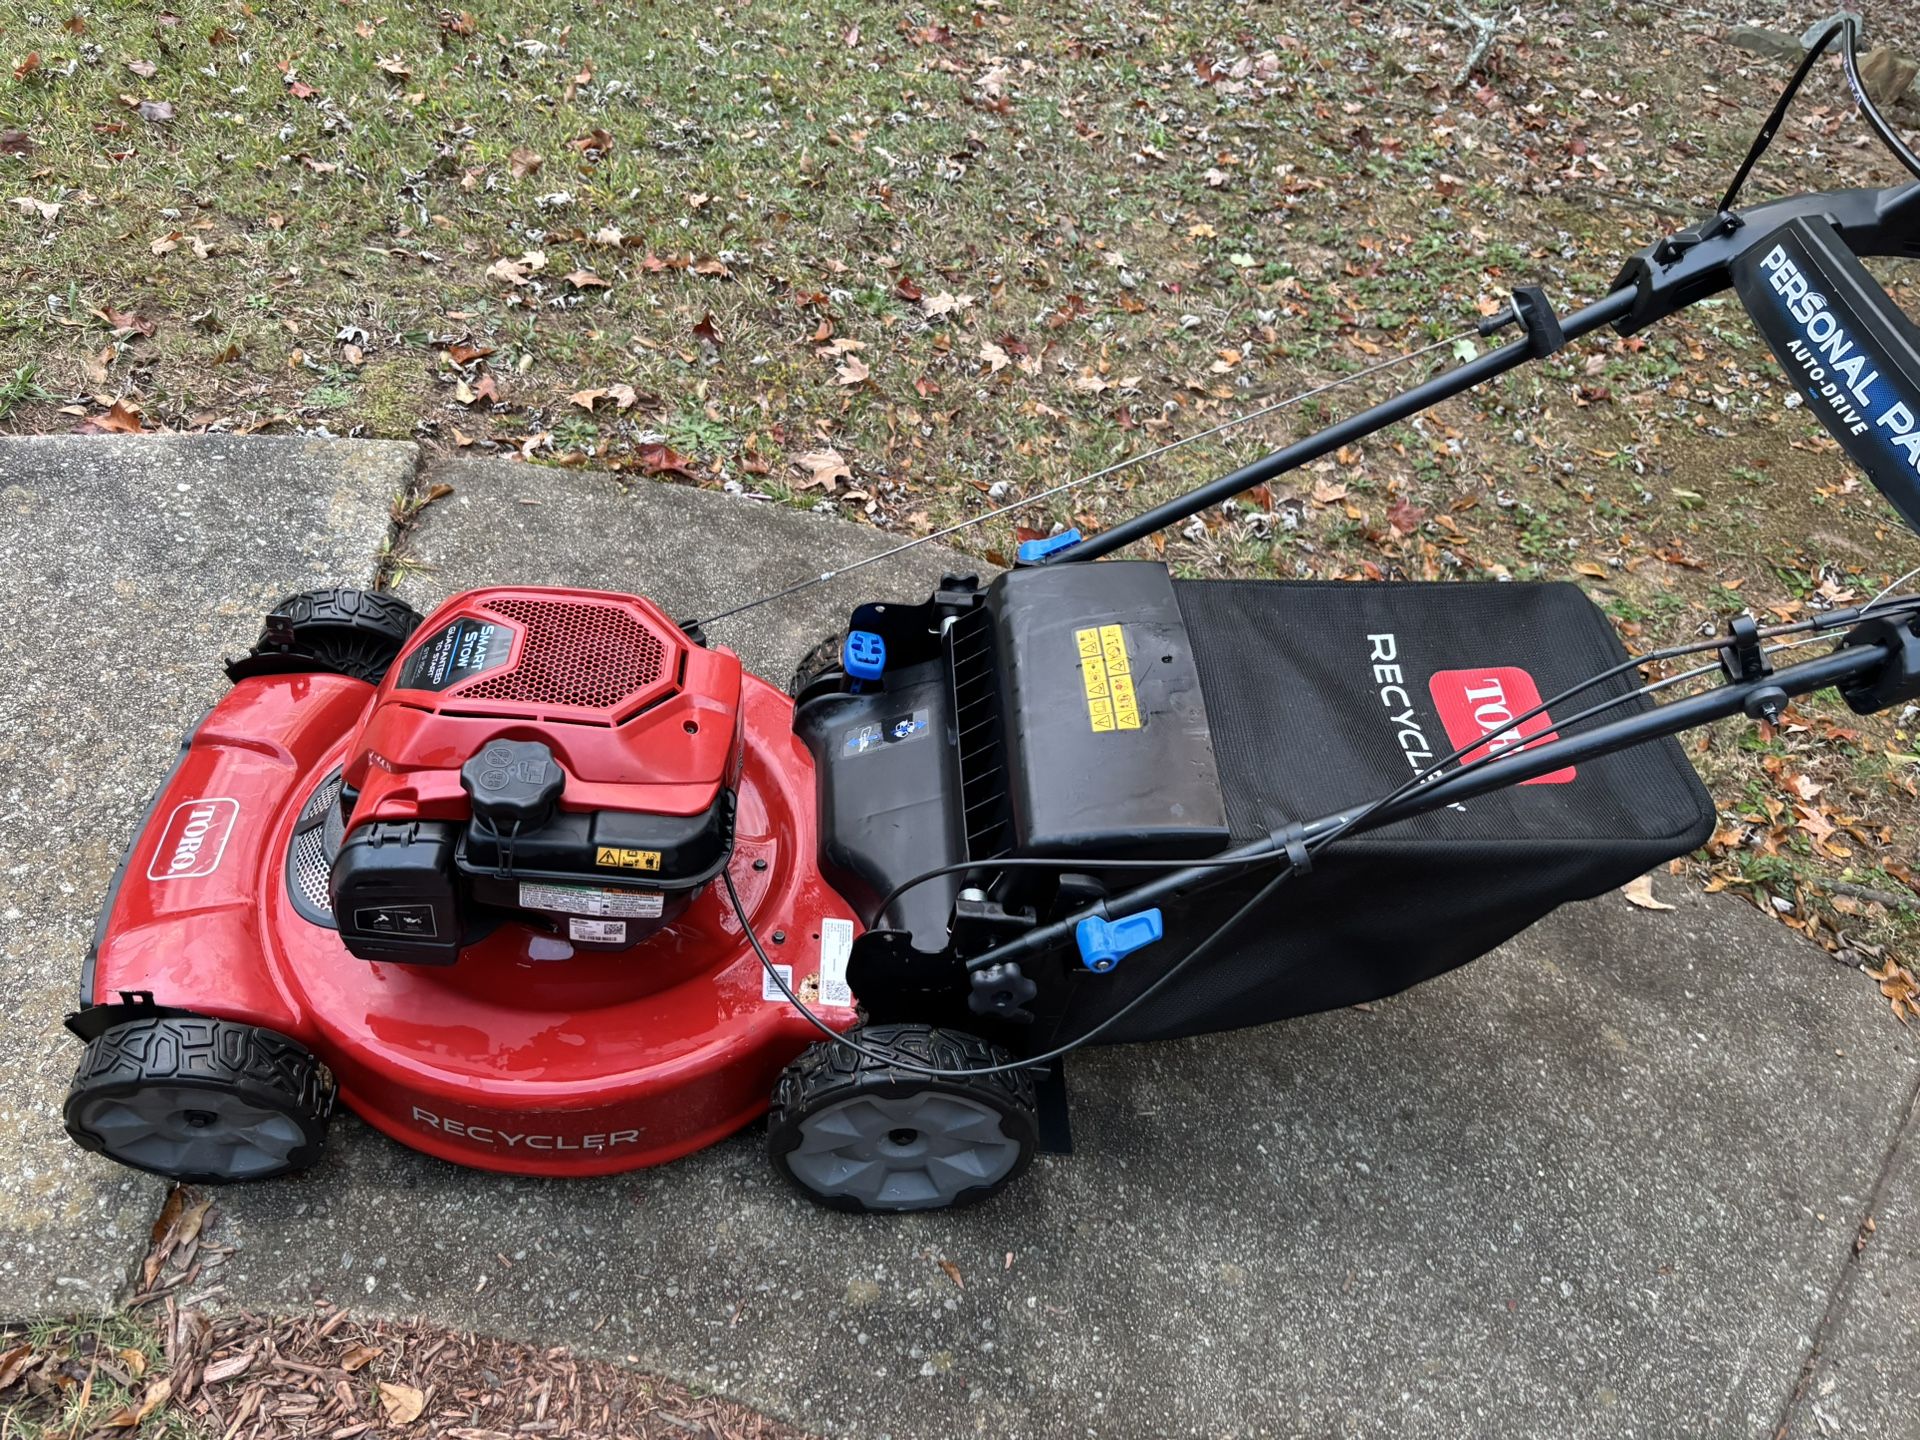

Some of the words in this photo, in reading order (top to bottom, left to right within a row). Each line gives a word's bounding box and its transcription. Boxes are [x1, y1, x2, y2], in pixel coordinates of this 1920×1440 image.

[1760, 244, 1879, 407] PERSONAL
[1876, 401, 1920, 475] PA
[1787, 340, 1869, 436] AUTO-DRIVE
[427, 652, 440, 677] START
[433, 626, 456, 684] GUARANTEED
[435, 640, 443, 651] TO
[457, 631, 478, 667] STOW
[471, 625, 495, 669] SMART
[1464, 678, 1526, 762] TOR
[170, 805, 216, 871] TORO
[412, 1106, 640, 1150] RECYCLER
